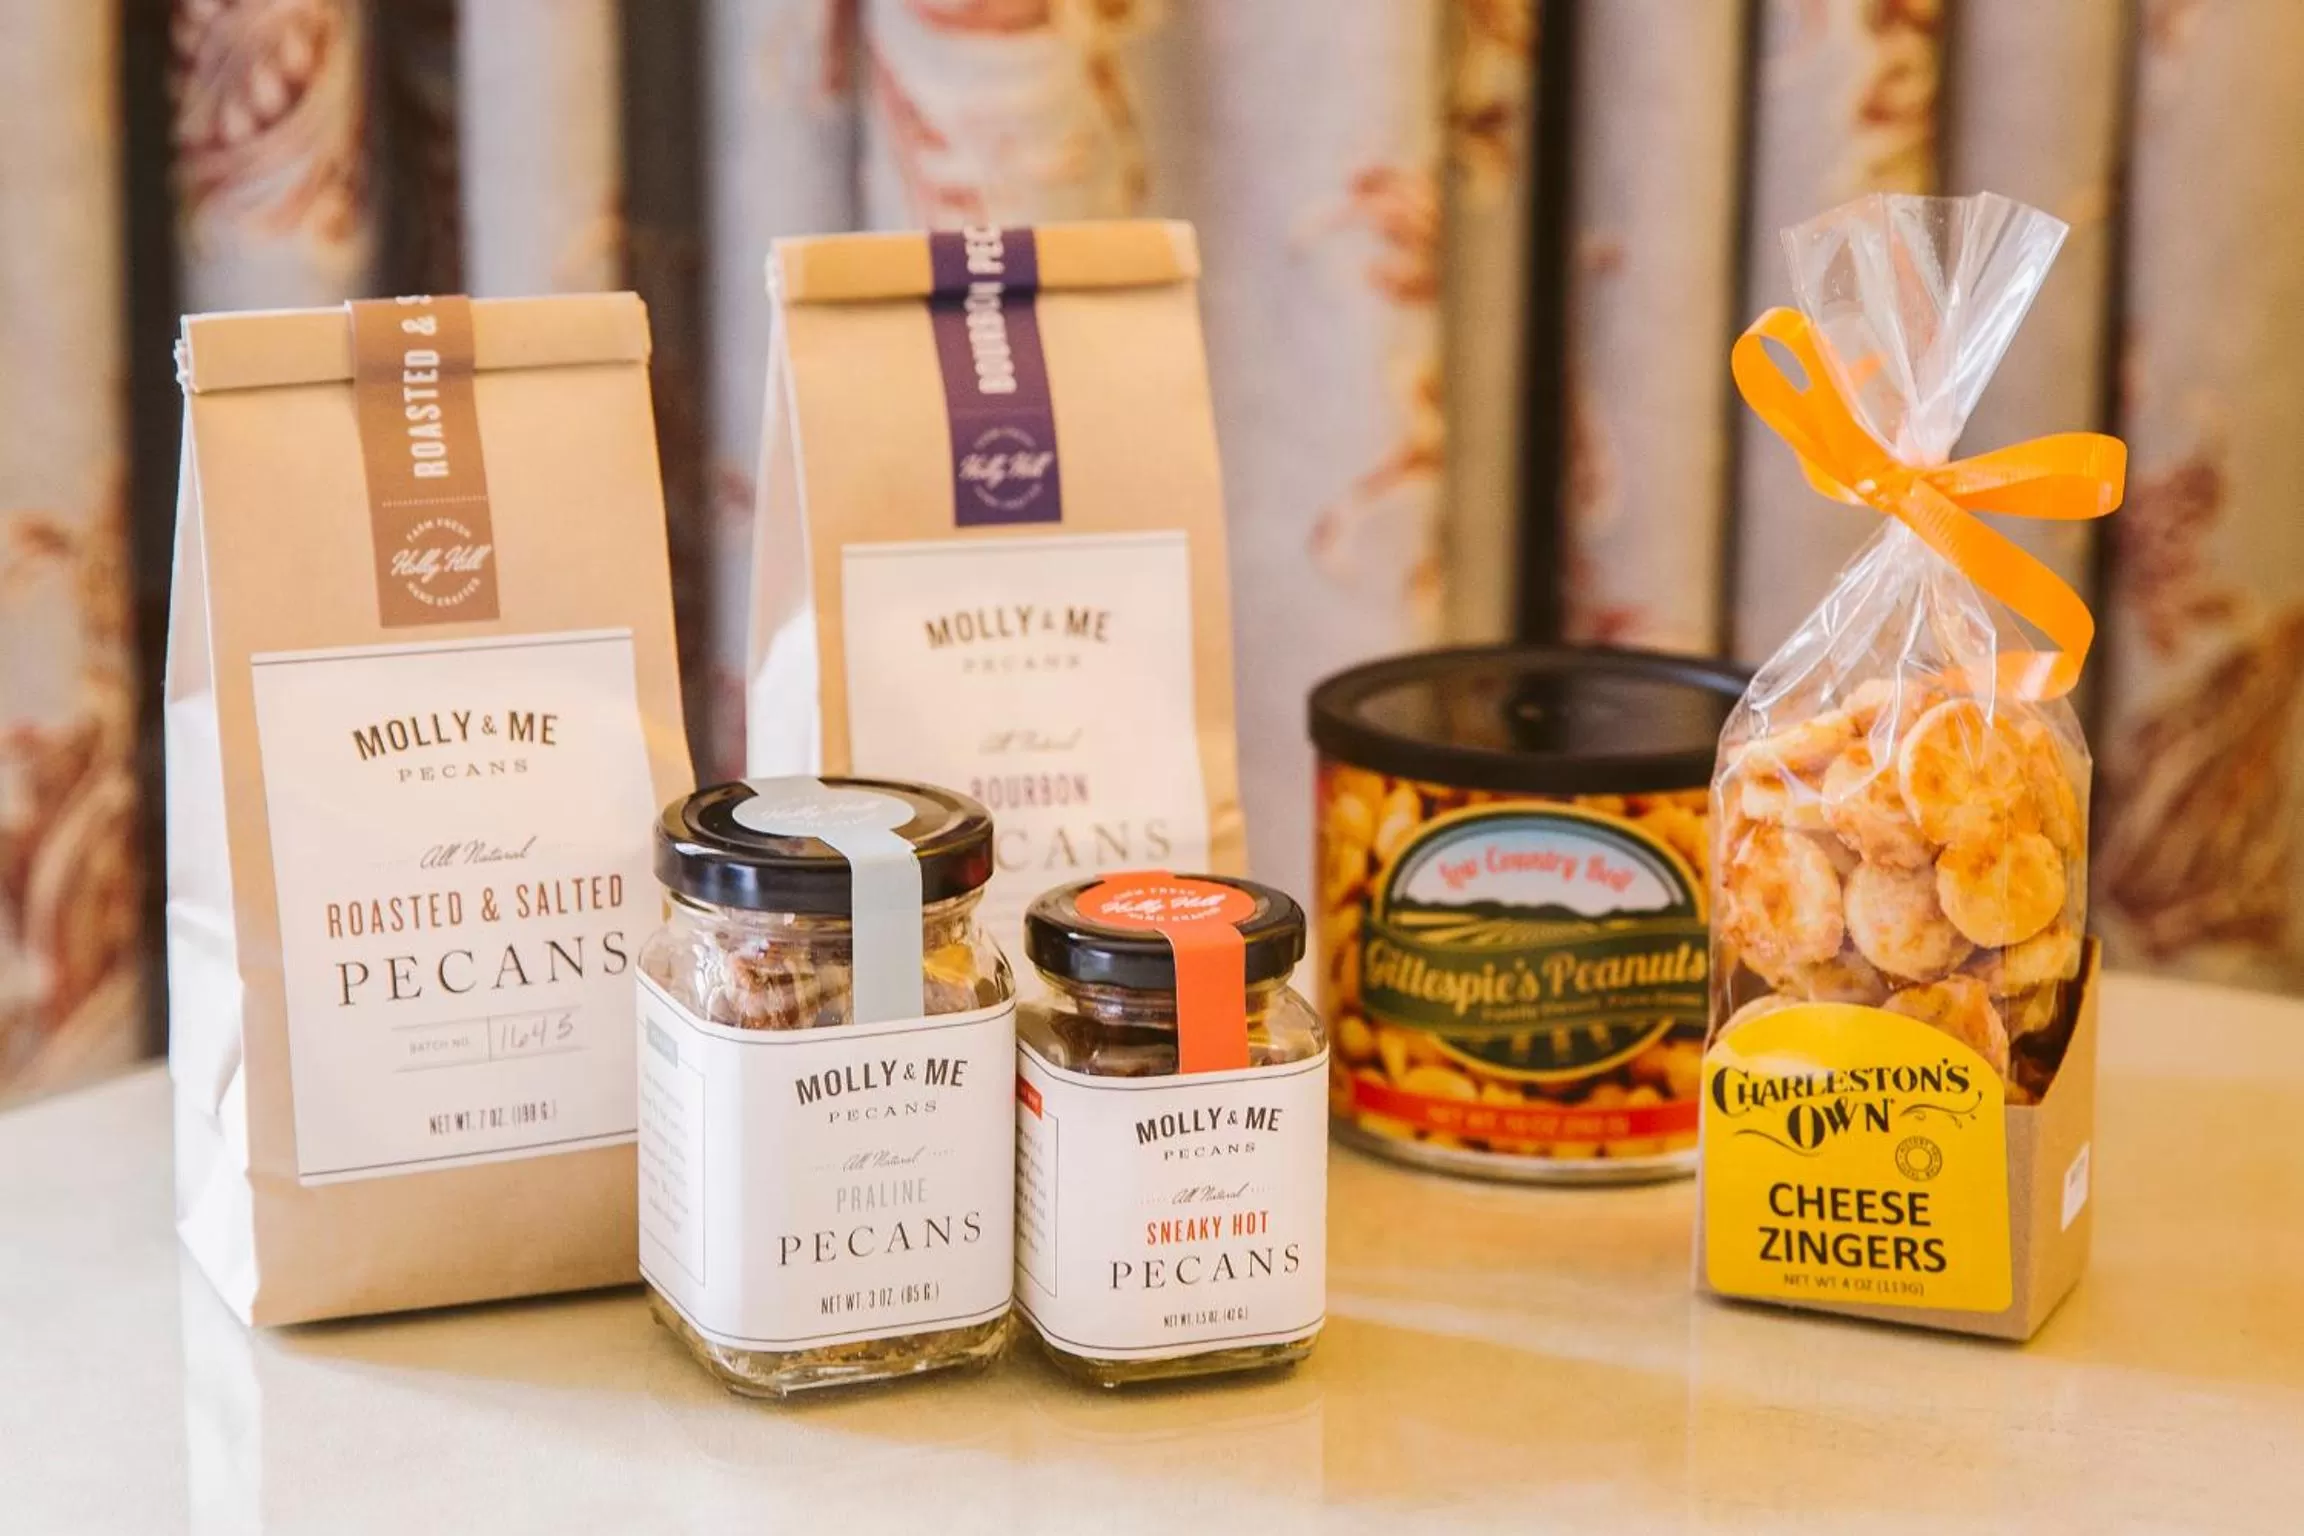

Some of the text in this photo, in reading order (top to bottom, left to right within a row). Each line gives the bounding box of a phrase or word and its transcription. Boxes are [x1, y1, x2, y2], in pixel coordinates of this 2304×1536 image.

[401, 314, 438, 336] &
[403, 349, 449, 478] ROASTED
[925, 605, 1032, 648] MOLLY
[1066, 606, 1114, 643] ME
[352, 710, 559, 761] MOLLY & ME
[398, 759, 529, 783] PECANS
[970, 773, 1090, 809] BOURBON
[420, 836, 537, 869] All Natural
[993, 818, 1172, 873] CANS
[328, 874, 624, 939] ROASTED & SALTED
[336, 931, 629, 1007] PECANS
[1366, 940, 1540, 1016] Gillespie's
[1541, 942, 1708, 997] Peanuts
[795, 1058, 968, 1106] MOLLY & ME
[429, 1113, 450, 1136] NET
[828, 1100, 938, 1124] PECANS
[1135, 1106, 1283, 1145] MOLLY & ME
[1163, 1141, 1256, 1161] PECANS
[836, 1177, 928, 1213] PRALINE
[1768, 1182, 1932, 1228] CHEESE
[776, 1210, 983, 1267] PECANS
[1146, 1210, 1269, 1246] SNEAKY HOT
[1109, 1243, 1301, 1291] PECANS
[1758, 1226, 1947, 1274] ZINGERS
[1784, 1273, 1809, 1286] NET
[821, 1294, 841, 1315] NET
[868, 1289, 875, 1309] 3
